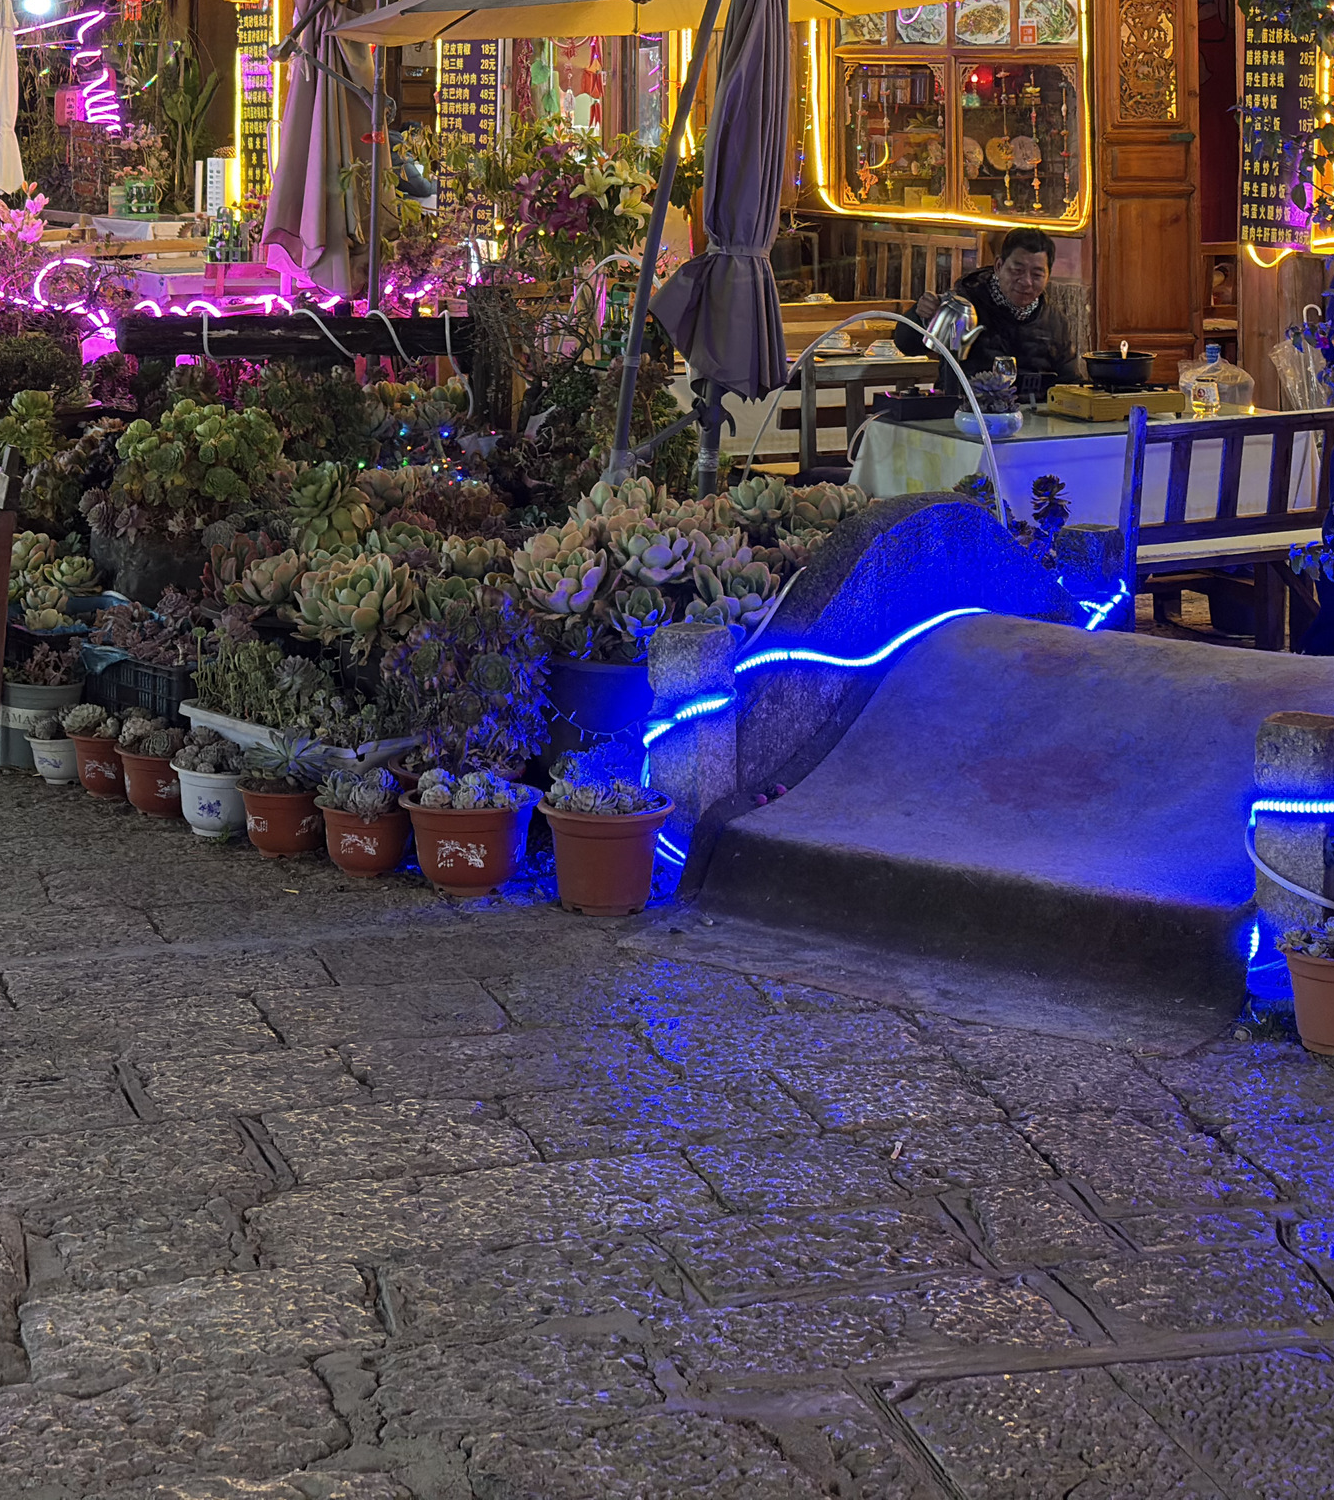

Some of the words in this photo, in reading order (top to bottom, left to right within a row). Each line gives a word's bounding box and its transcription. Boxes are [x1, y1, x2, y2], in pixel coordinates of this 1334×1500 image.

[480, 43, 496, 56] 18元
[480, 58, 496, 71] 28元
[1299, 51, 1315, 66] 28元
[480, 73, 496, 85] 35元
[1246, 72, 1285, 88] 野生菌米线
[1299, 73, 1315, 88] 20元
[479, 103, 495, 116] 48元
[1245, 94, 1278, 110] 鸡蛋炒饭
[1299, 118, 1314, 133] 18元
[1244, 159, 1279, 176] 牛肉炒饭
[1243, 181, 1286, 199] 野生菌炒饭
[1242, 203, 1291, 222] 鸡蛋火腿炒饭
[1242, 225, 1292, 243] 腊肉牛肝菌炒饭
